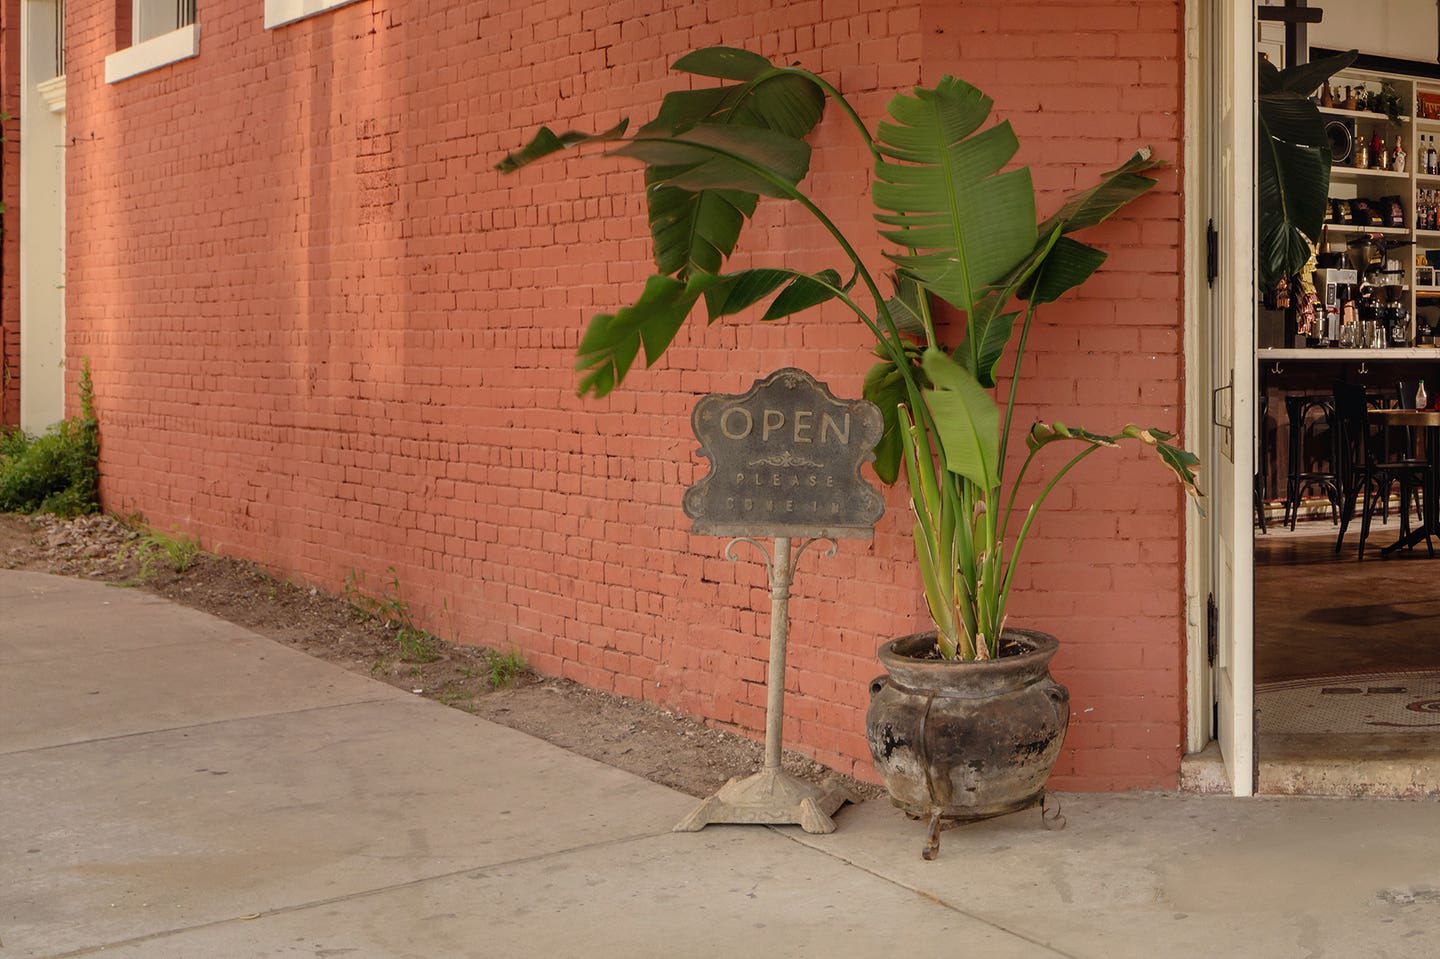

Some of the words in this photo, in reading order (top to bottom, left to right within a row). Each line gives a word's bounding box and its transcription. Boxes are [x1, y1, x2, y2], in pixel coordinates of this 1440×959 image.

[720, 407, 850, 445] OPEN
[736, 472, 834, 487] PLEASE
[726, 496, 793, 512] COME
